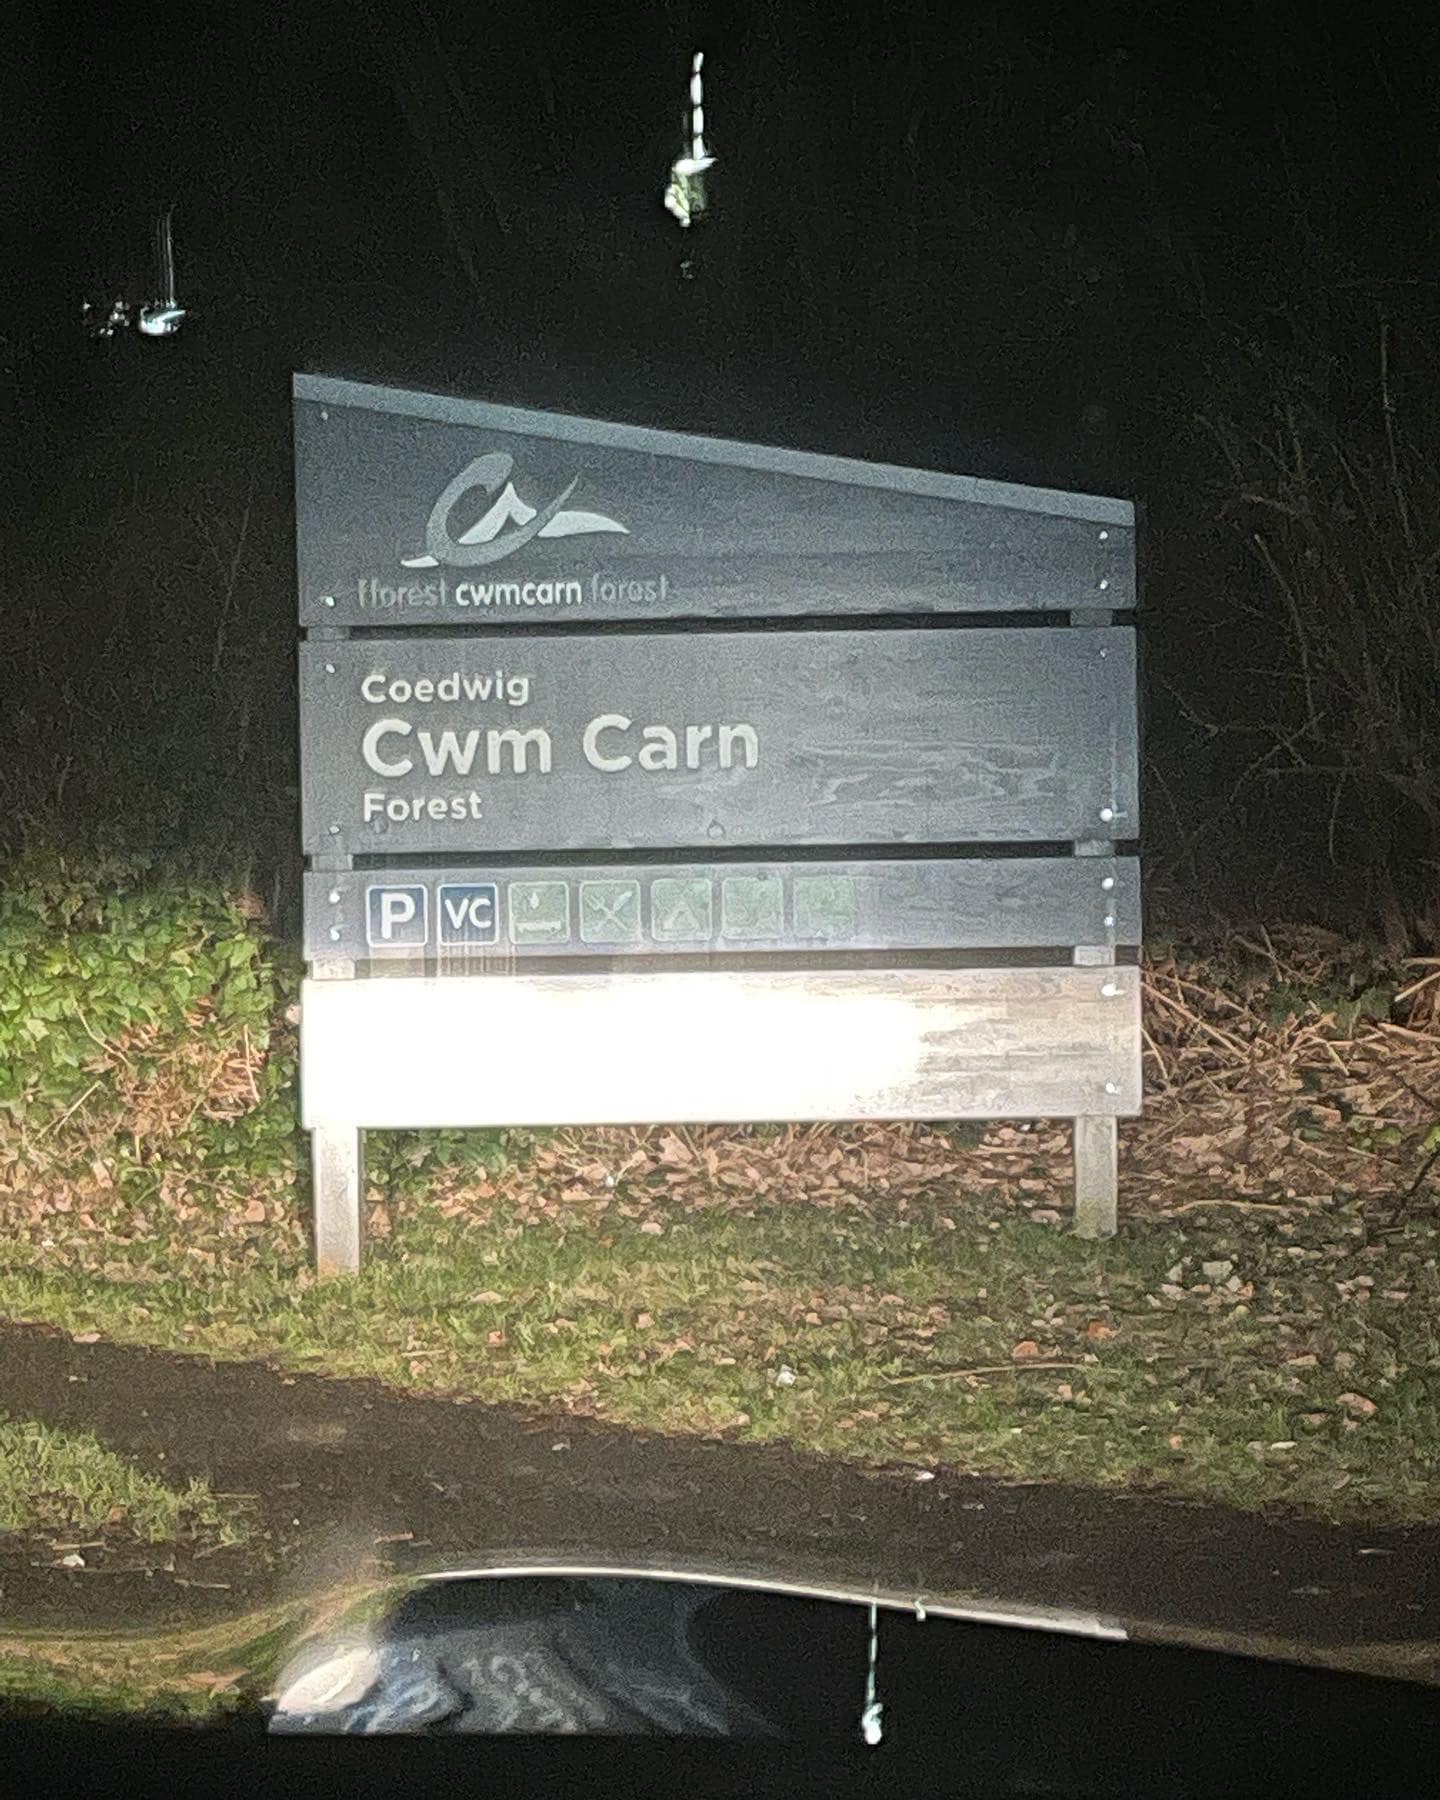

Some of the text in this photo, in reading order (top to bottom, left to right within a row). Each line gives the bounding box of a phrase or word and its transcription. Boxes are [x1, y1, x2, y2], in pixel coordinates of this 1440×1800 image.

[455, 581, 582, 606] cwmcarn
[361, 671, 530, 706] Coedwig
[362, 713, 759, 777] Cwm Carn
[363, 791, 483, 822] Forest
[380, 893, 415, 939] P
[445, 897, 493, 929] VC
